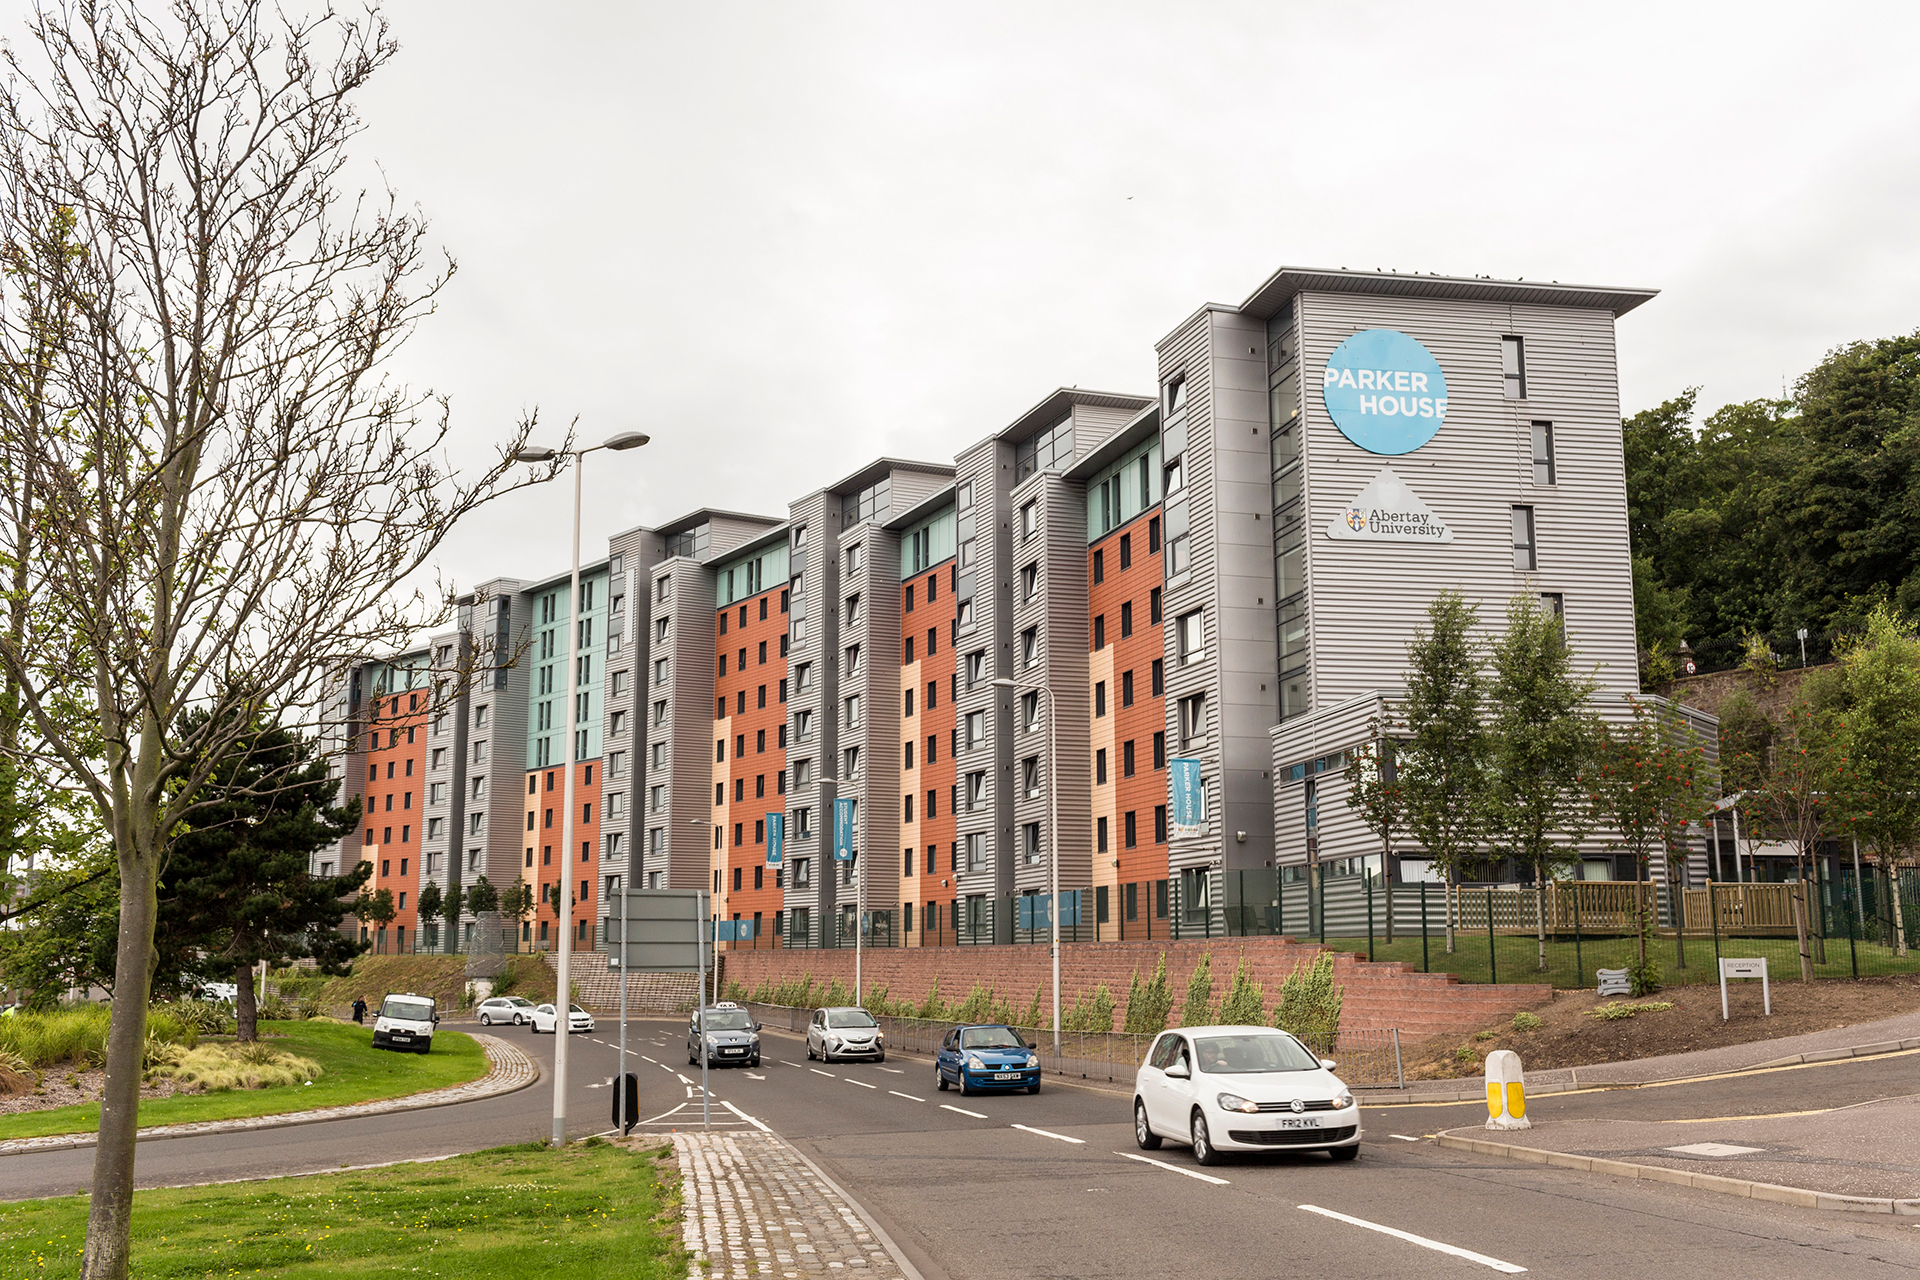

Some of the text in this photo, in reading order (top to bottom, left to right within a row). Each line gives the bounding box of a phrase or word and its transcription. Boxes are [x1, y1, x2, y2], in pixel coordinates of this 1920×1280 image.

[1324, 368, 1428, 392] PARKER
[1360, 394, 1447, 418] HOUSE
[1369, 509, 1429, 525] Abertay
[1369, 521, 1445, 538] University
[1183, 762, 1193, 819] PARKER HOUSE
[1282, 1119, 1301, 1128] FR12
